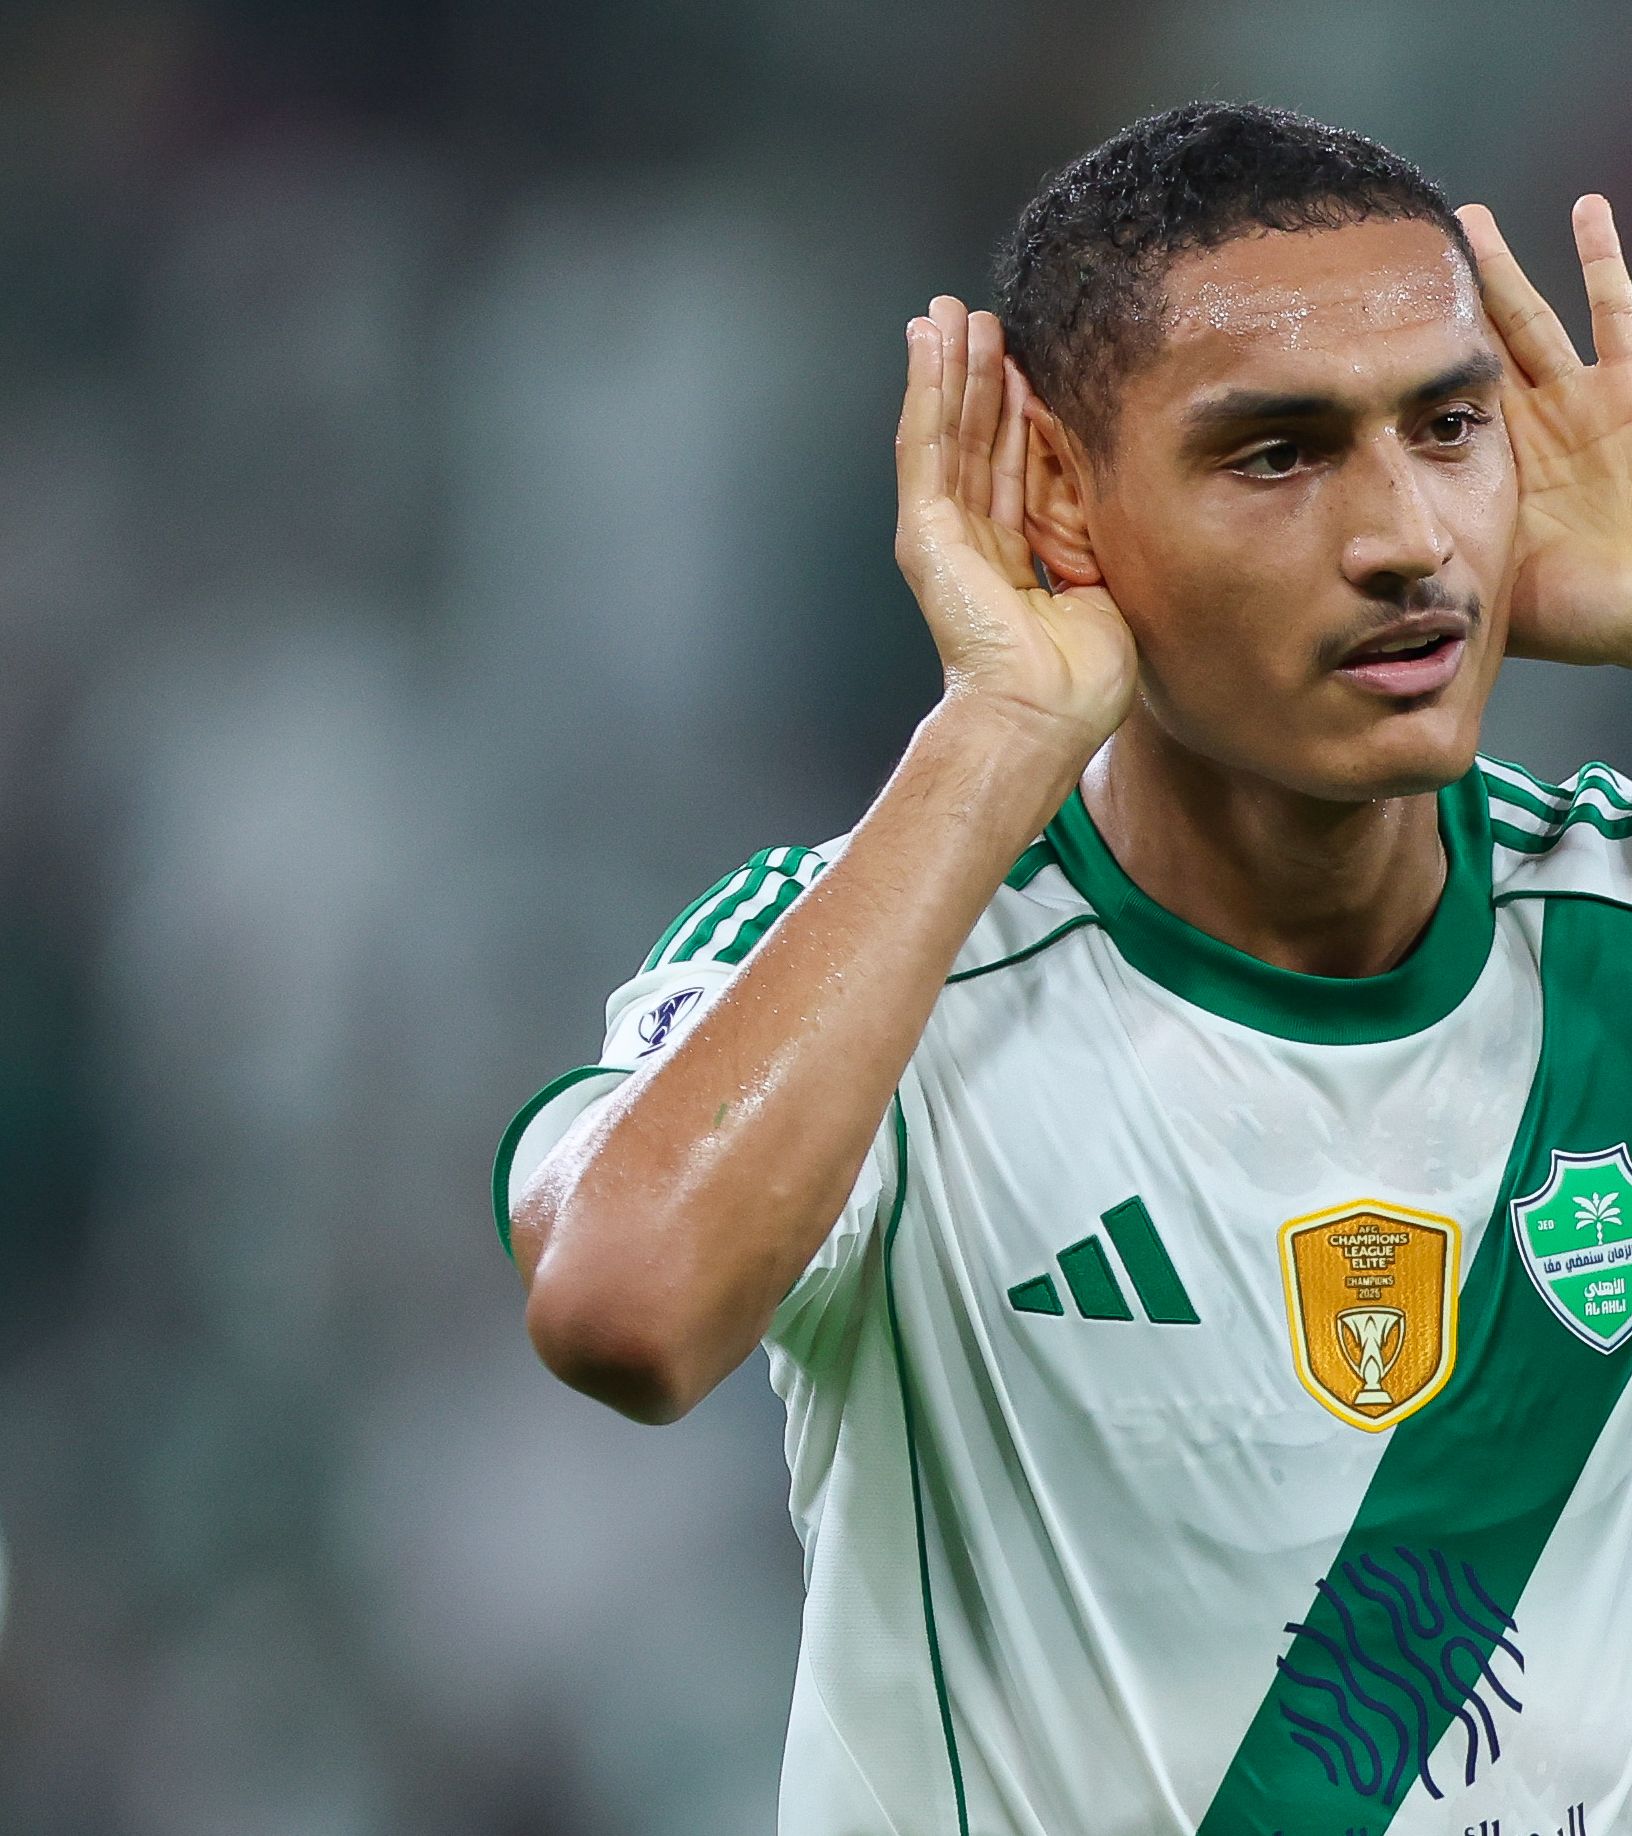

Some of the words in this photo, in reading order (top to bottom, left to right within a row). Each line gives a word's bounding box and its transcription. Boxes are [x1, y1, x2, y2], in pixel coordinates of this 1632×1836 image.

[1359, 1226, 1378, 1234] AFC
[1537, 1220, 1555, 1231] JED
[1330, 1233, 1408, 1245] CHAMPIONS
[1344, 1245, 1394, 1257] LEAGUE
[1565, 1251, 1604, 1273] سنمضي
[1346, 1276, 1394, 1286] CHAMPIONS
[1585, 1300, 1600, 1316] AL
[1601, 1299, 1626, 1315] AHLI
